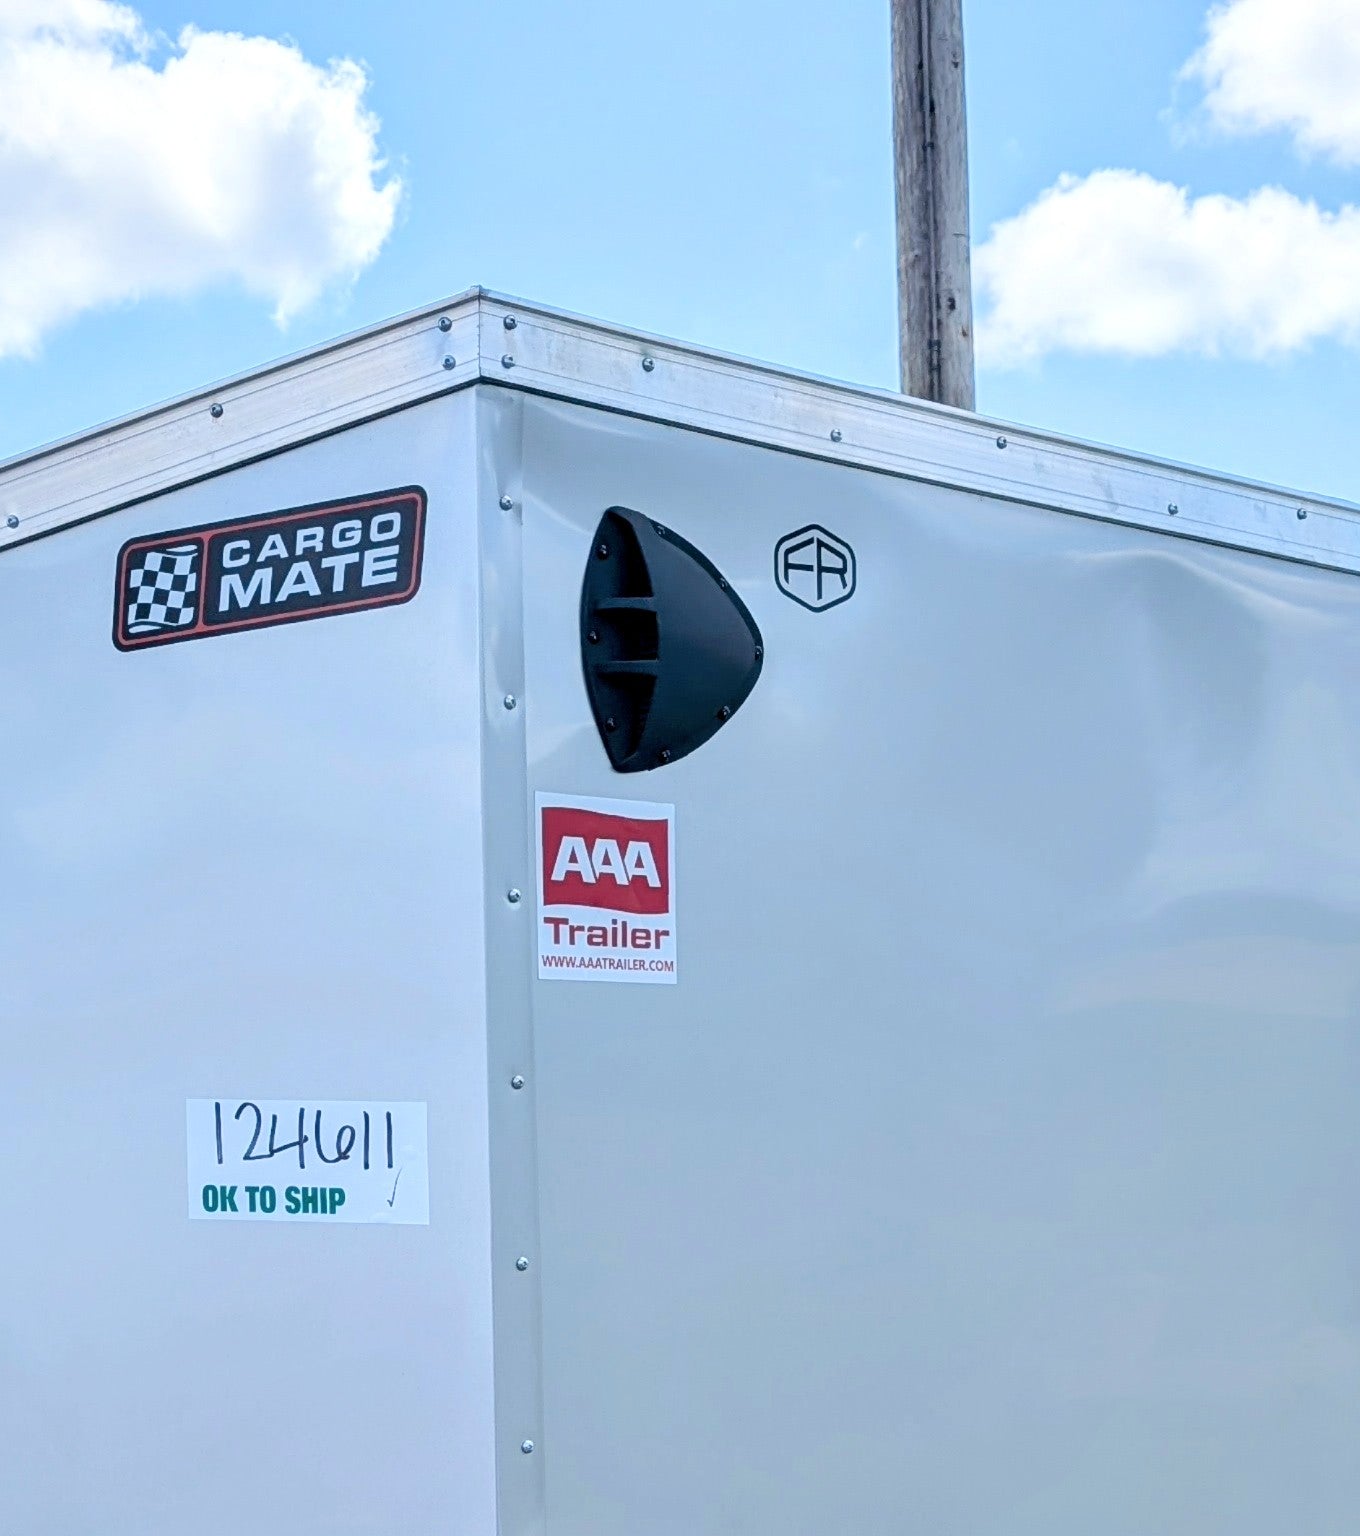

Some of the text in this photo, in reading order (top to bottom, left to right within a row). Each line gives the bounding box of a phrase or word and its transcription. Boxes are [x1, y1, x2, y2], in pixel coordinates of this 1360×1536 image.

[221, 511, 402, 569] CARGO
[217, 544, 401, 613] MATE
[550, 835, 662, 888] AAA
[543, 916, 670, 950] Trailer
[541, 954, 674, 973] WWW.AAATRAILER.COM
[214, 1101, 395, 1170] 124611
[202, 1184, 346, 1215] OK TO SHIP
